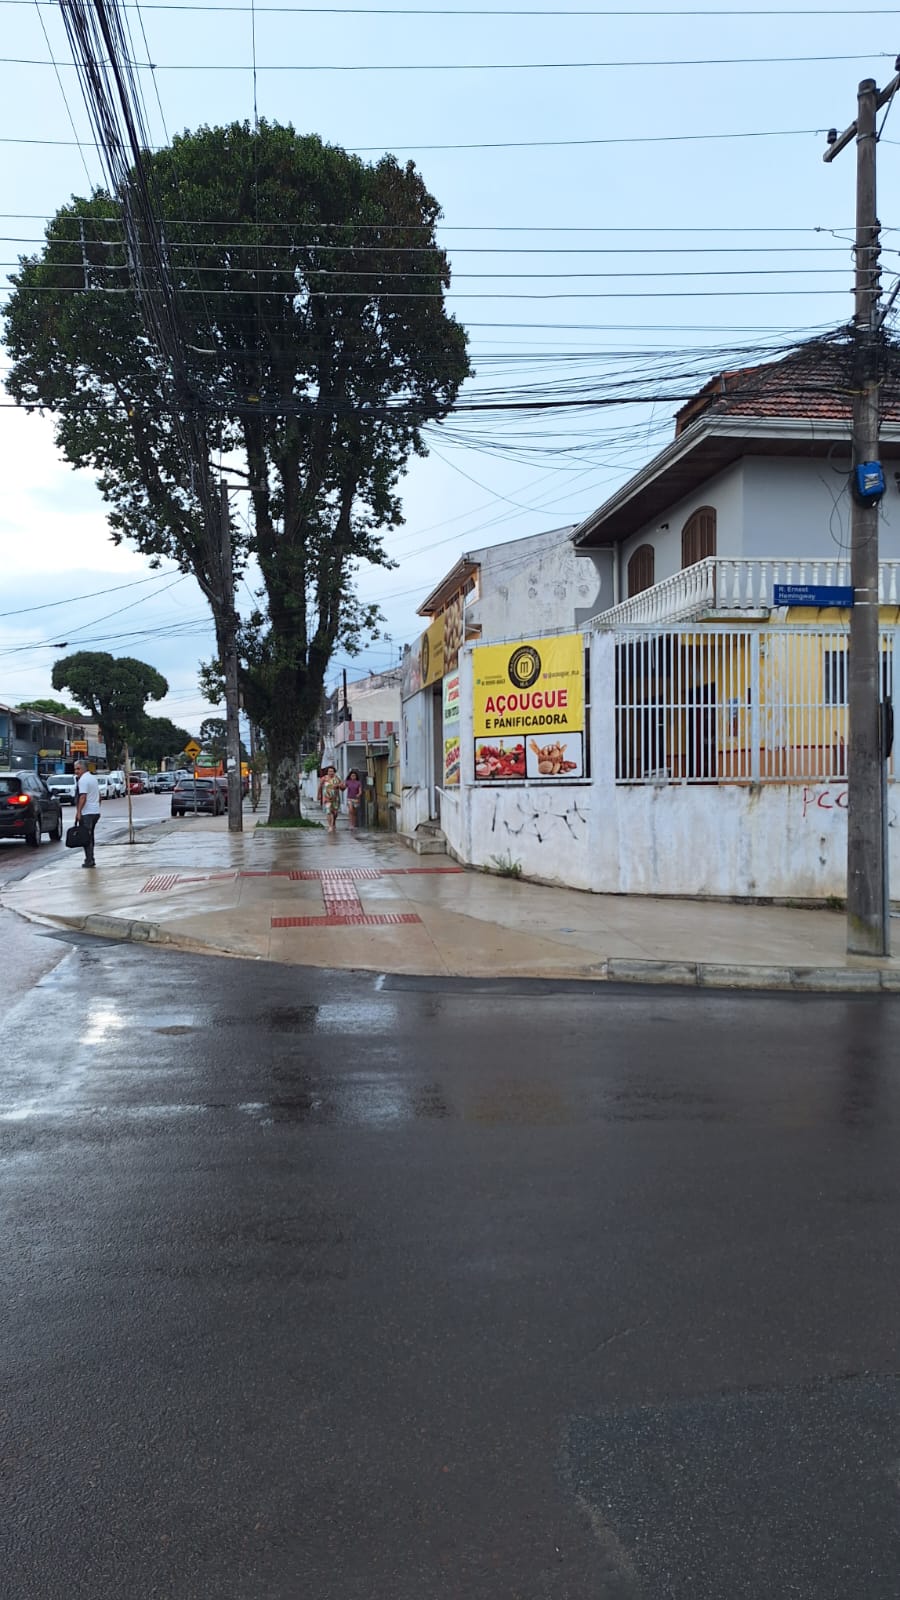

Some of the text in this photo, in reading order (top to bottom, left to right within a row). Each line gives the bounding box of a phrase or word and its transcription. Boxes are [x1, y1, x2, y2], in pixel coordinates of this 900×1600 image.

[485, 689, 568, 716] AÇOUGUE
[485, 713, 568, 729] E PANIFICADORA
